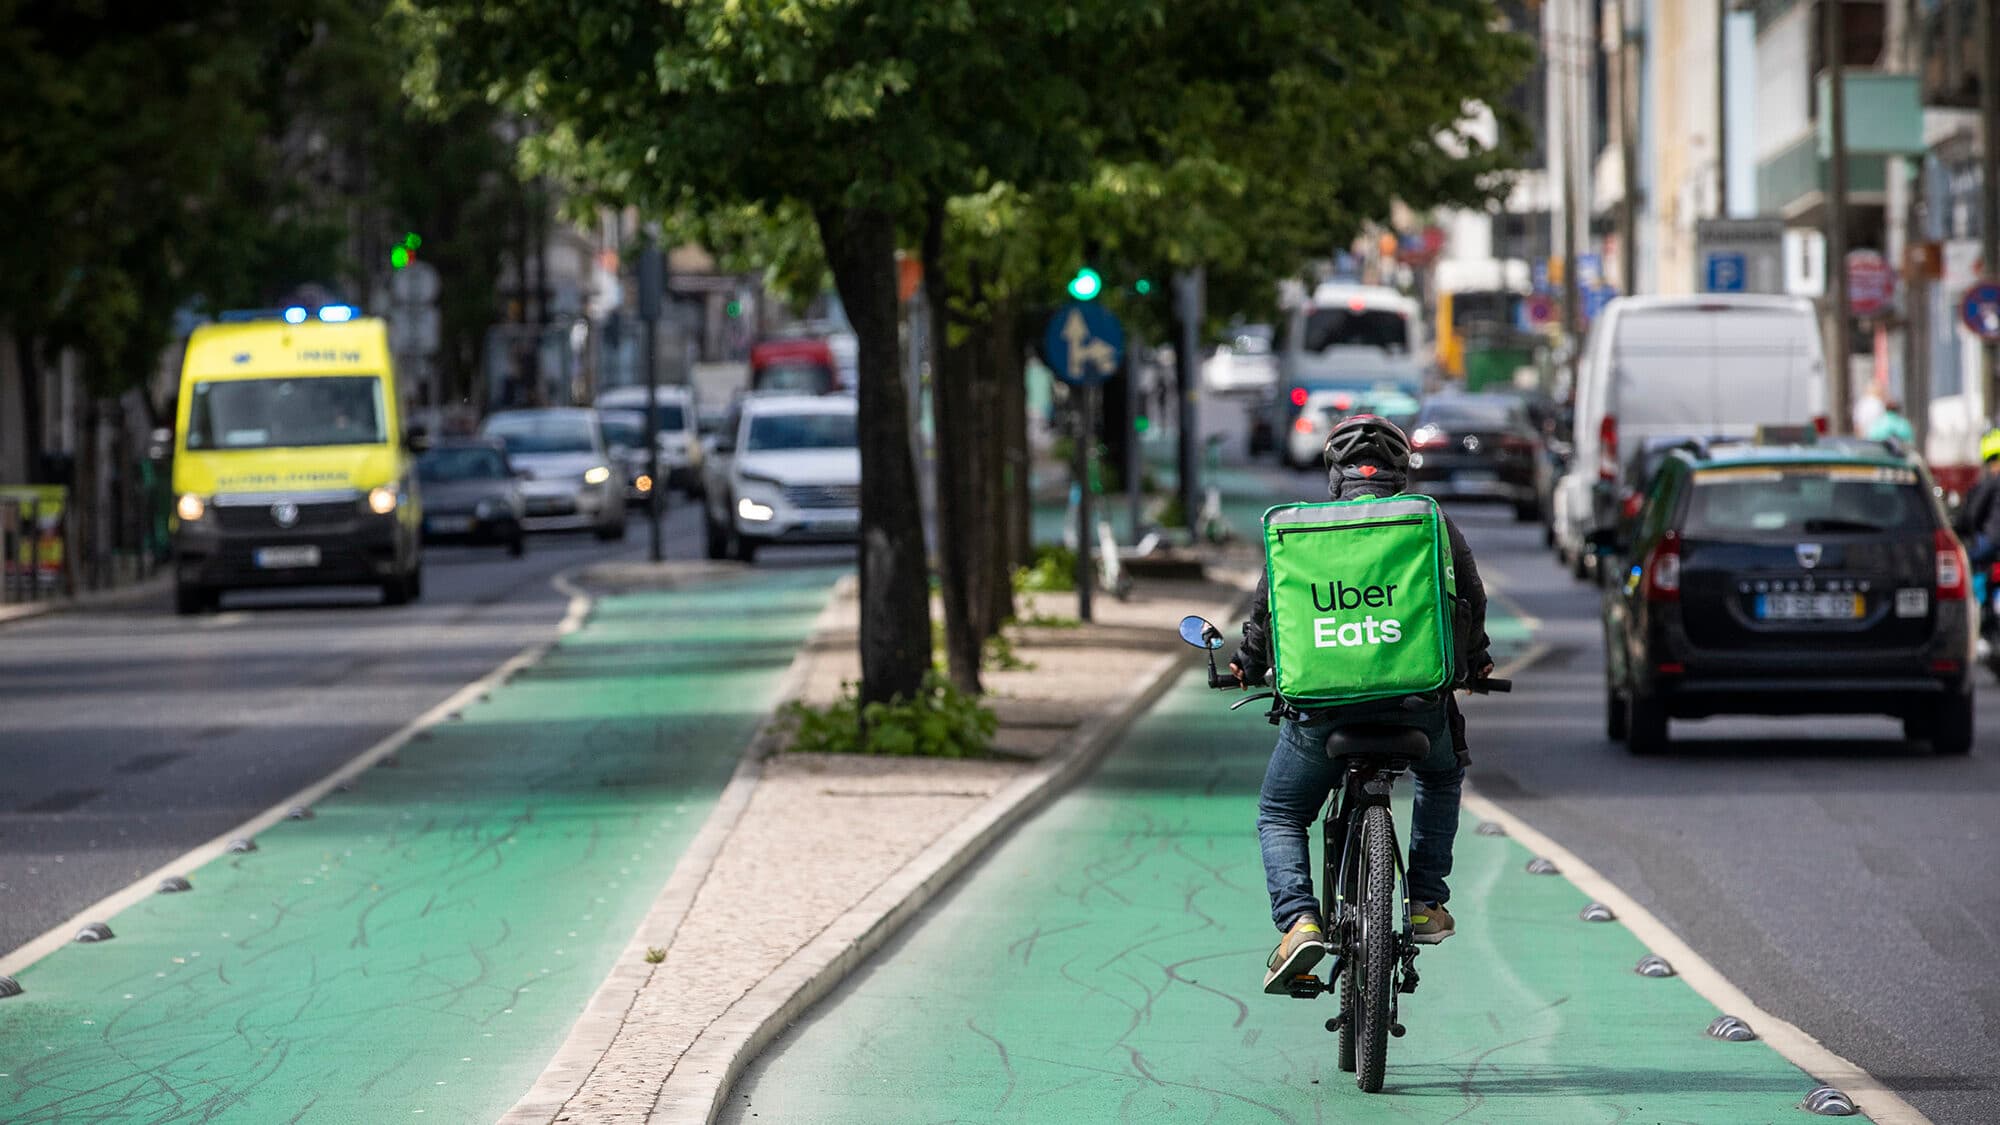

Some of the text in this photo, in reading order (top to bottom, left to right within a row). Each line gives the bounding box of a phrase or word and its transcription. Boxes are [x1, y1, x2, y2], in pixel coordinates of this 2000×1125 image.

[1716, 261, 1737, 290] P
[1311, 581, 1397, 612] Uber
[1314, 616, 1402, 648] Eats
